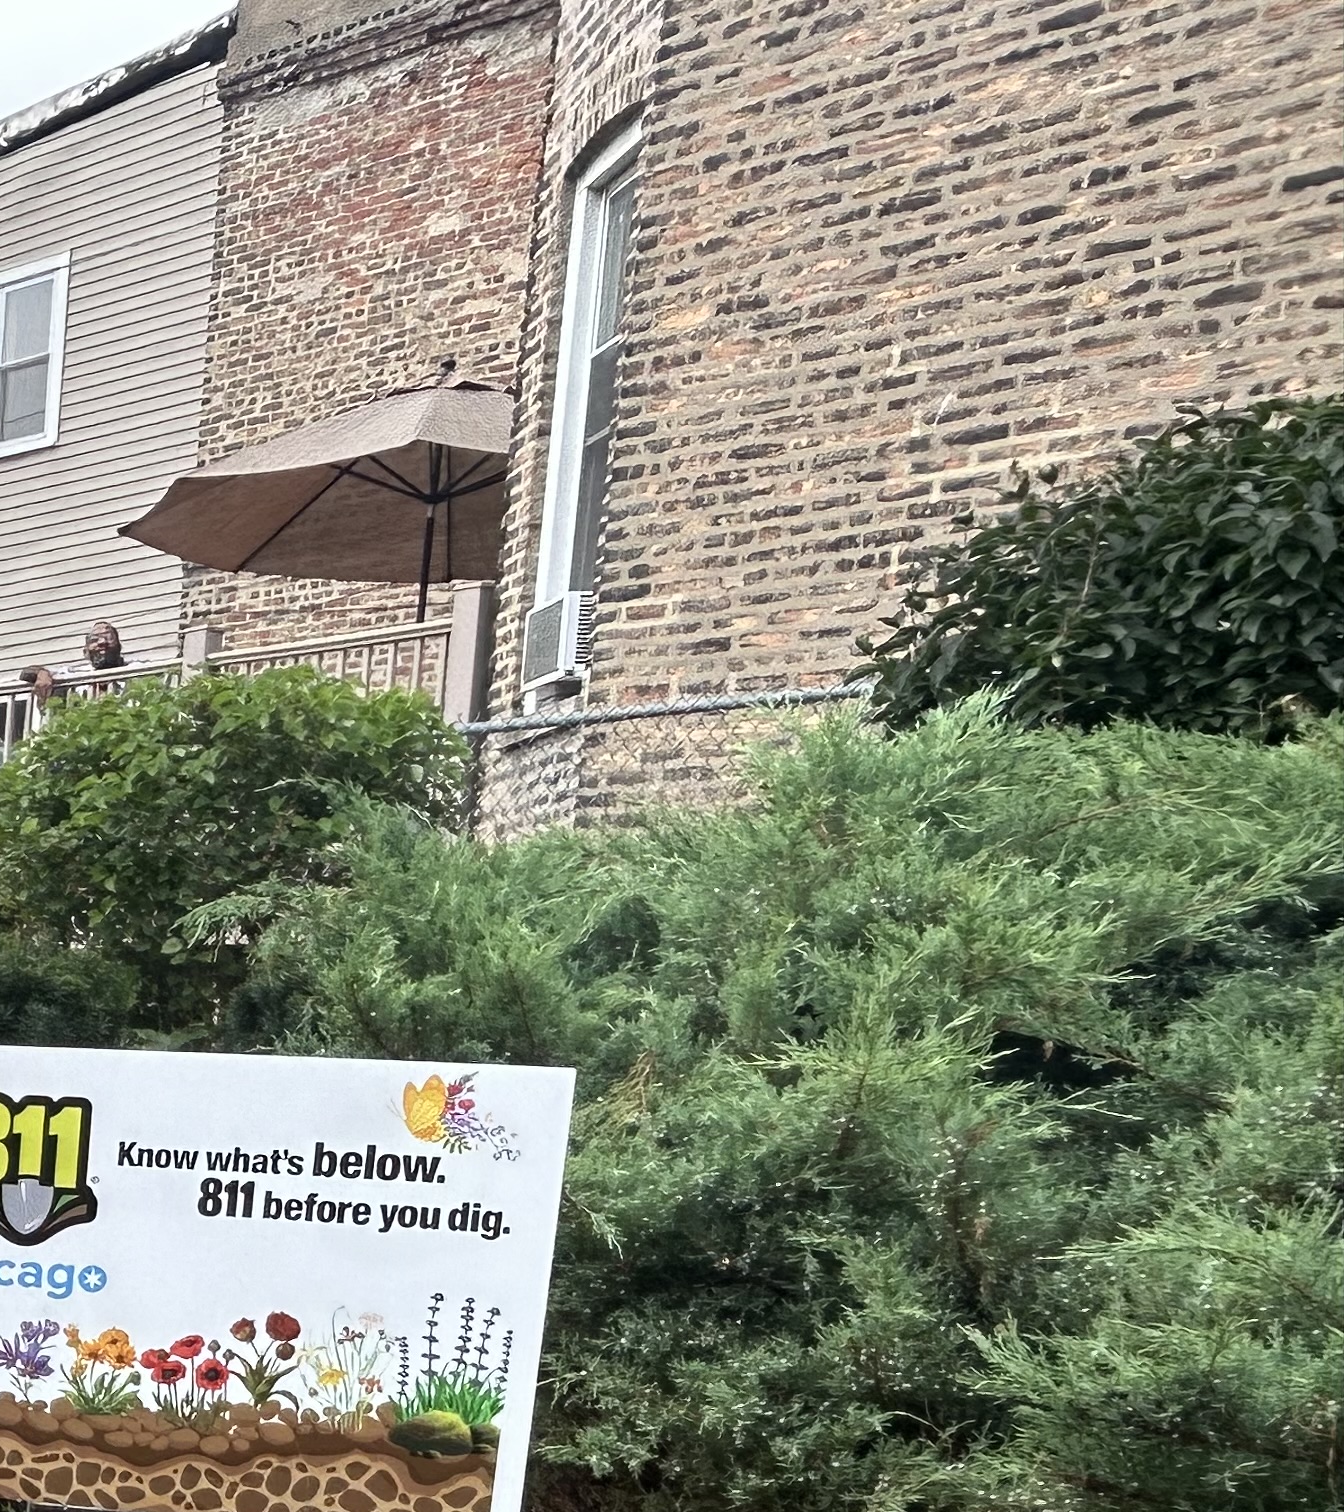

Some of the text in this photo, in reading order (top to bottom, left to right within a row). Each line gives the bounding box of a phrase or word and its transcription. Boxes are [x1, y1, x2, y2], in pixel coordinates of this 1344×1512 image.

[117, 1141, 446, 1183] Know what's below.
[197, 1177, 511, 1240] 811 before you dig.
